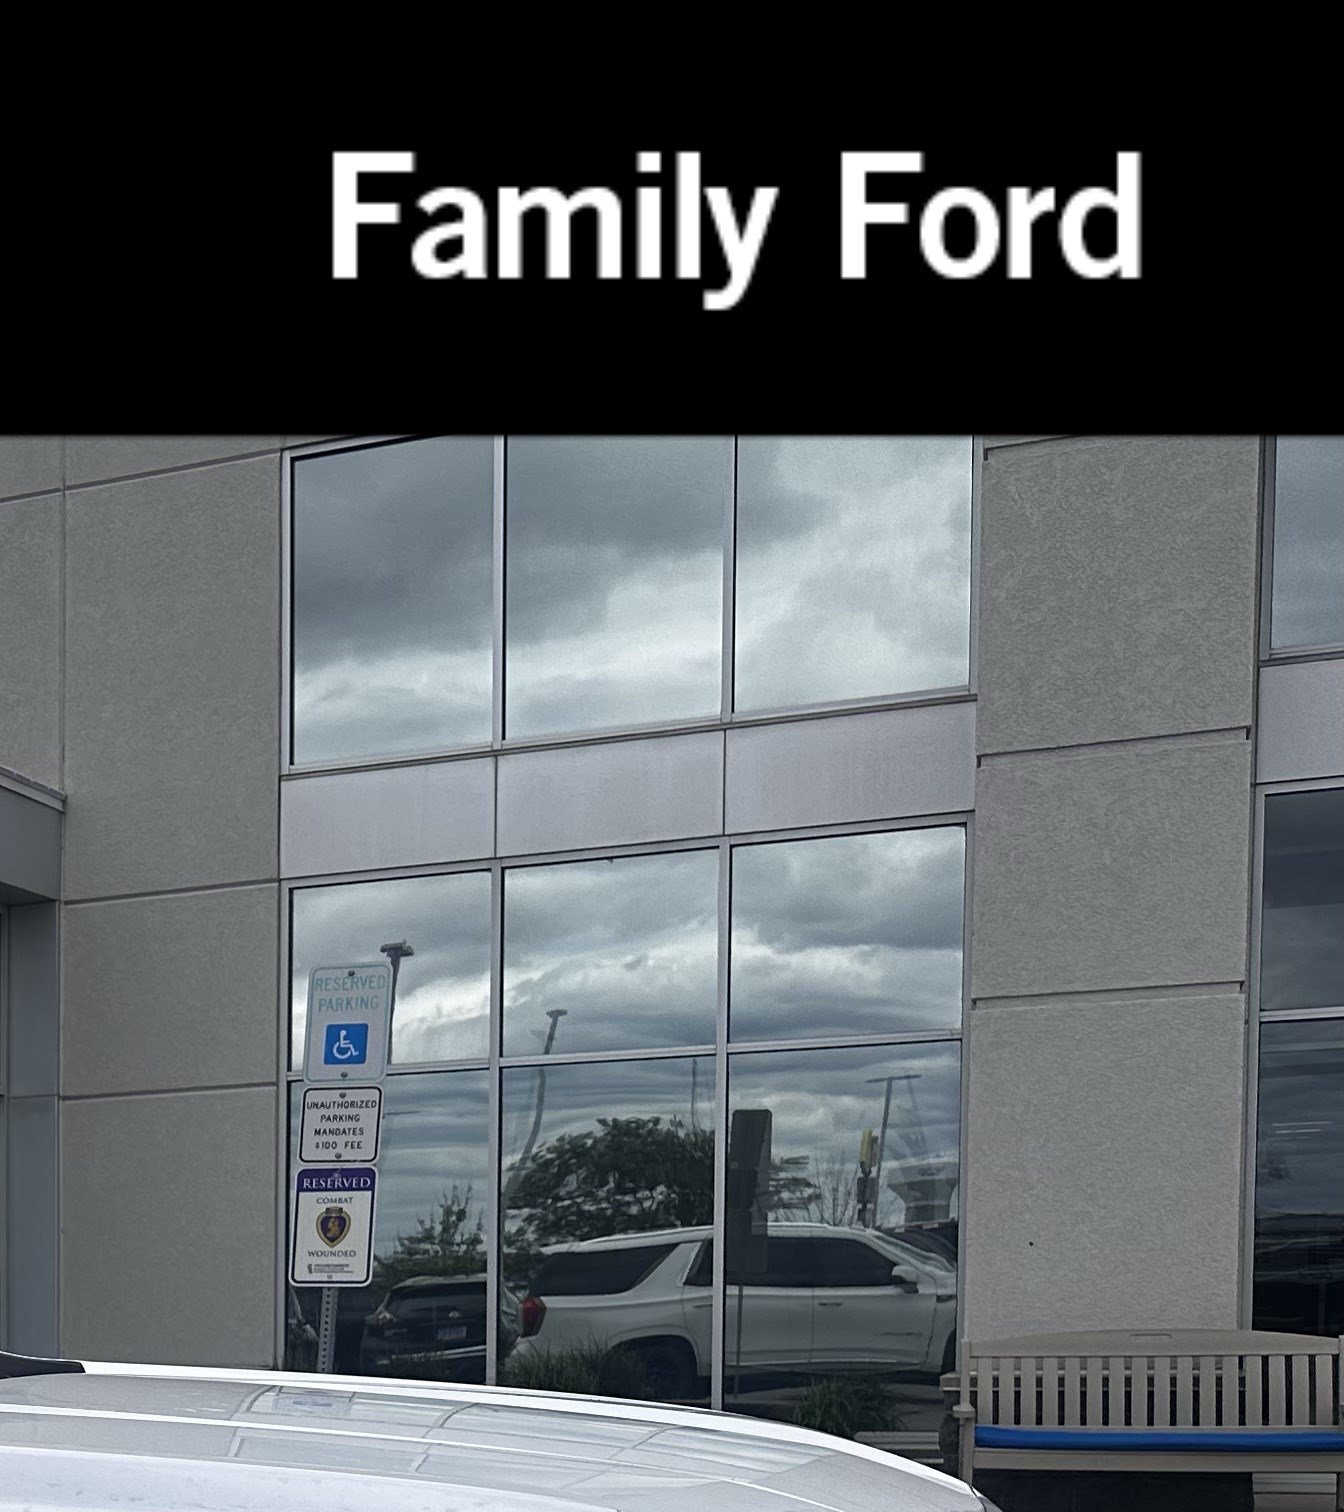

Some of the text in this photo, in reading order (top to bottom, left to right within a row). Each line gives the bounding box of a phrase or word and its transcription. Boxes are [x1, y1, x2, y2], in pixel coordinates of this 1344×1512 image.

[315, 975, 386, 992] RESERVED
[318, 995, 379, 1012] PARKING
[306, 1100, 377, 1110] UNAUTHORIZED
[320, 1114, 361, 1123] PARKING
[314, 1127, 364, 1136] MANDATES
[315, 1140, 363, 1150] $100 FEE
[302, 1176, 371, 1189] RESERVED
